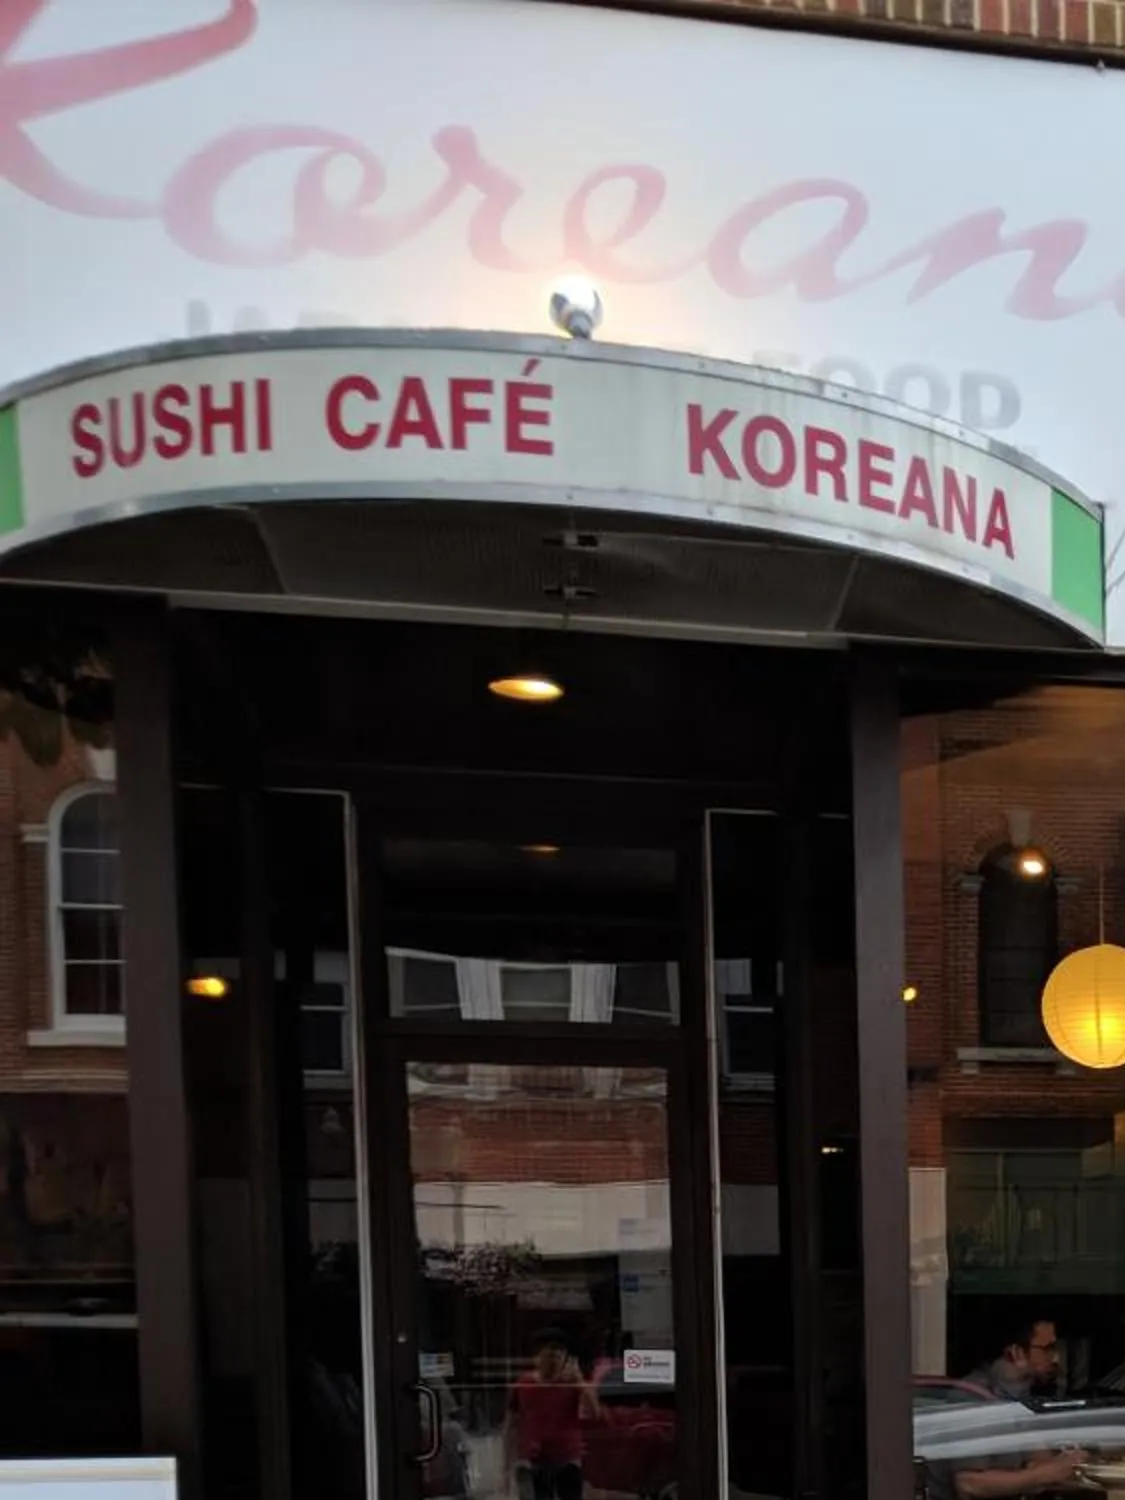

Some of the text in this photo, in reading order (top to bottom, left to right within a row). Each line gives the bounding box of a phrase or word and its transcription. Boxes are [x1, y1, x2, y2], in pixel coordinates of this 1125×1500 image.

[71, 358, 1015, 560] SUSHI CAFÉ KOREANA
[752, 350, 1021, 430] OOD
